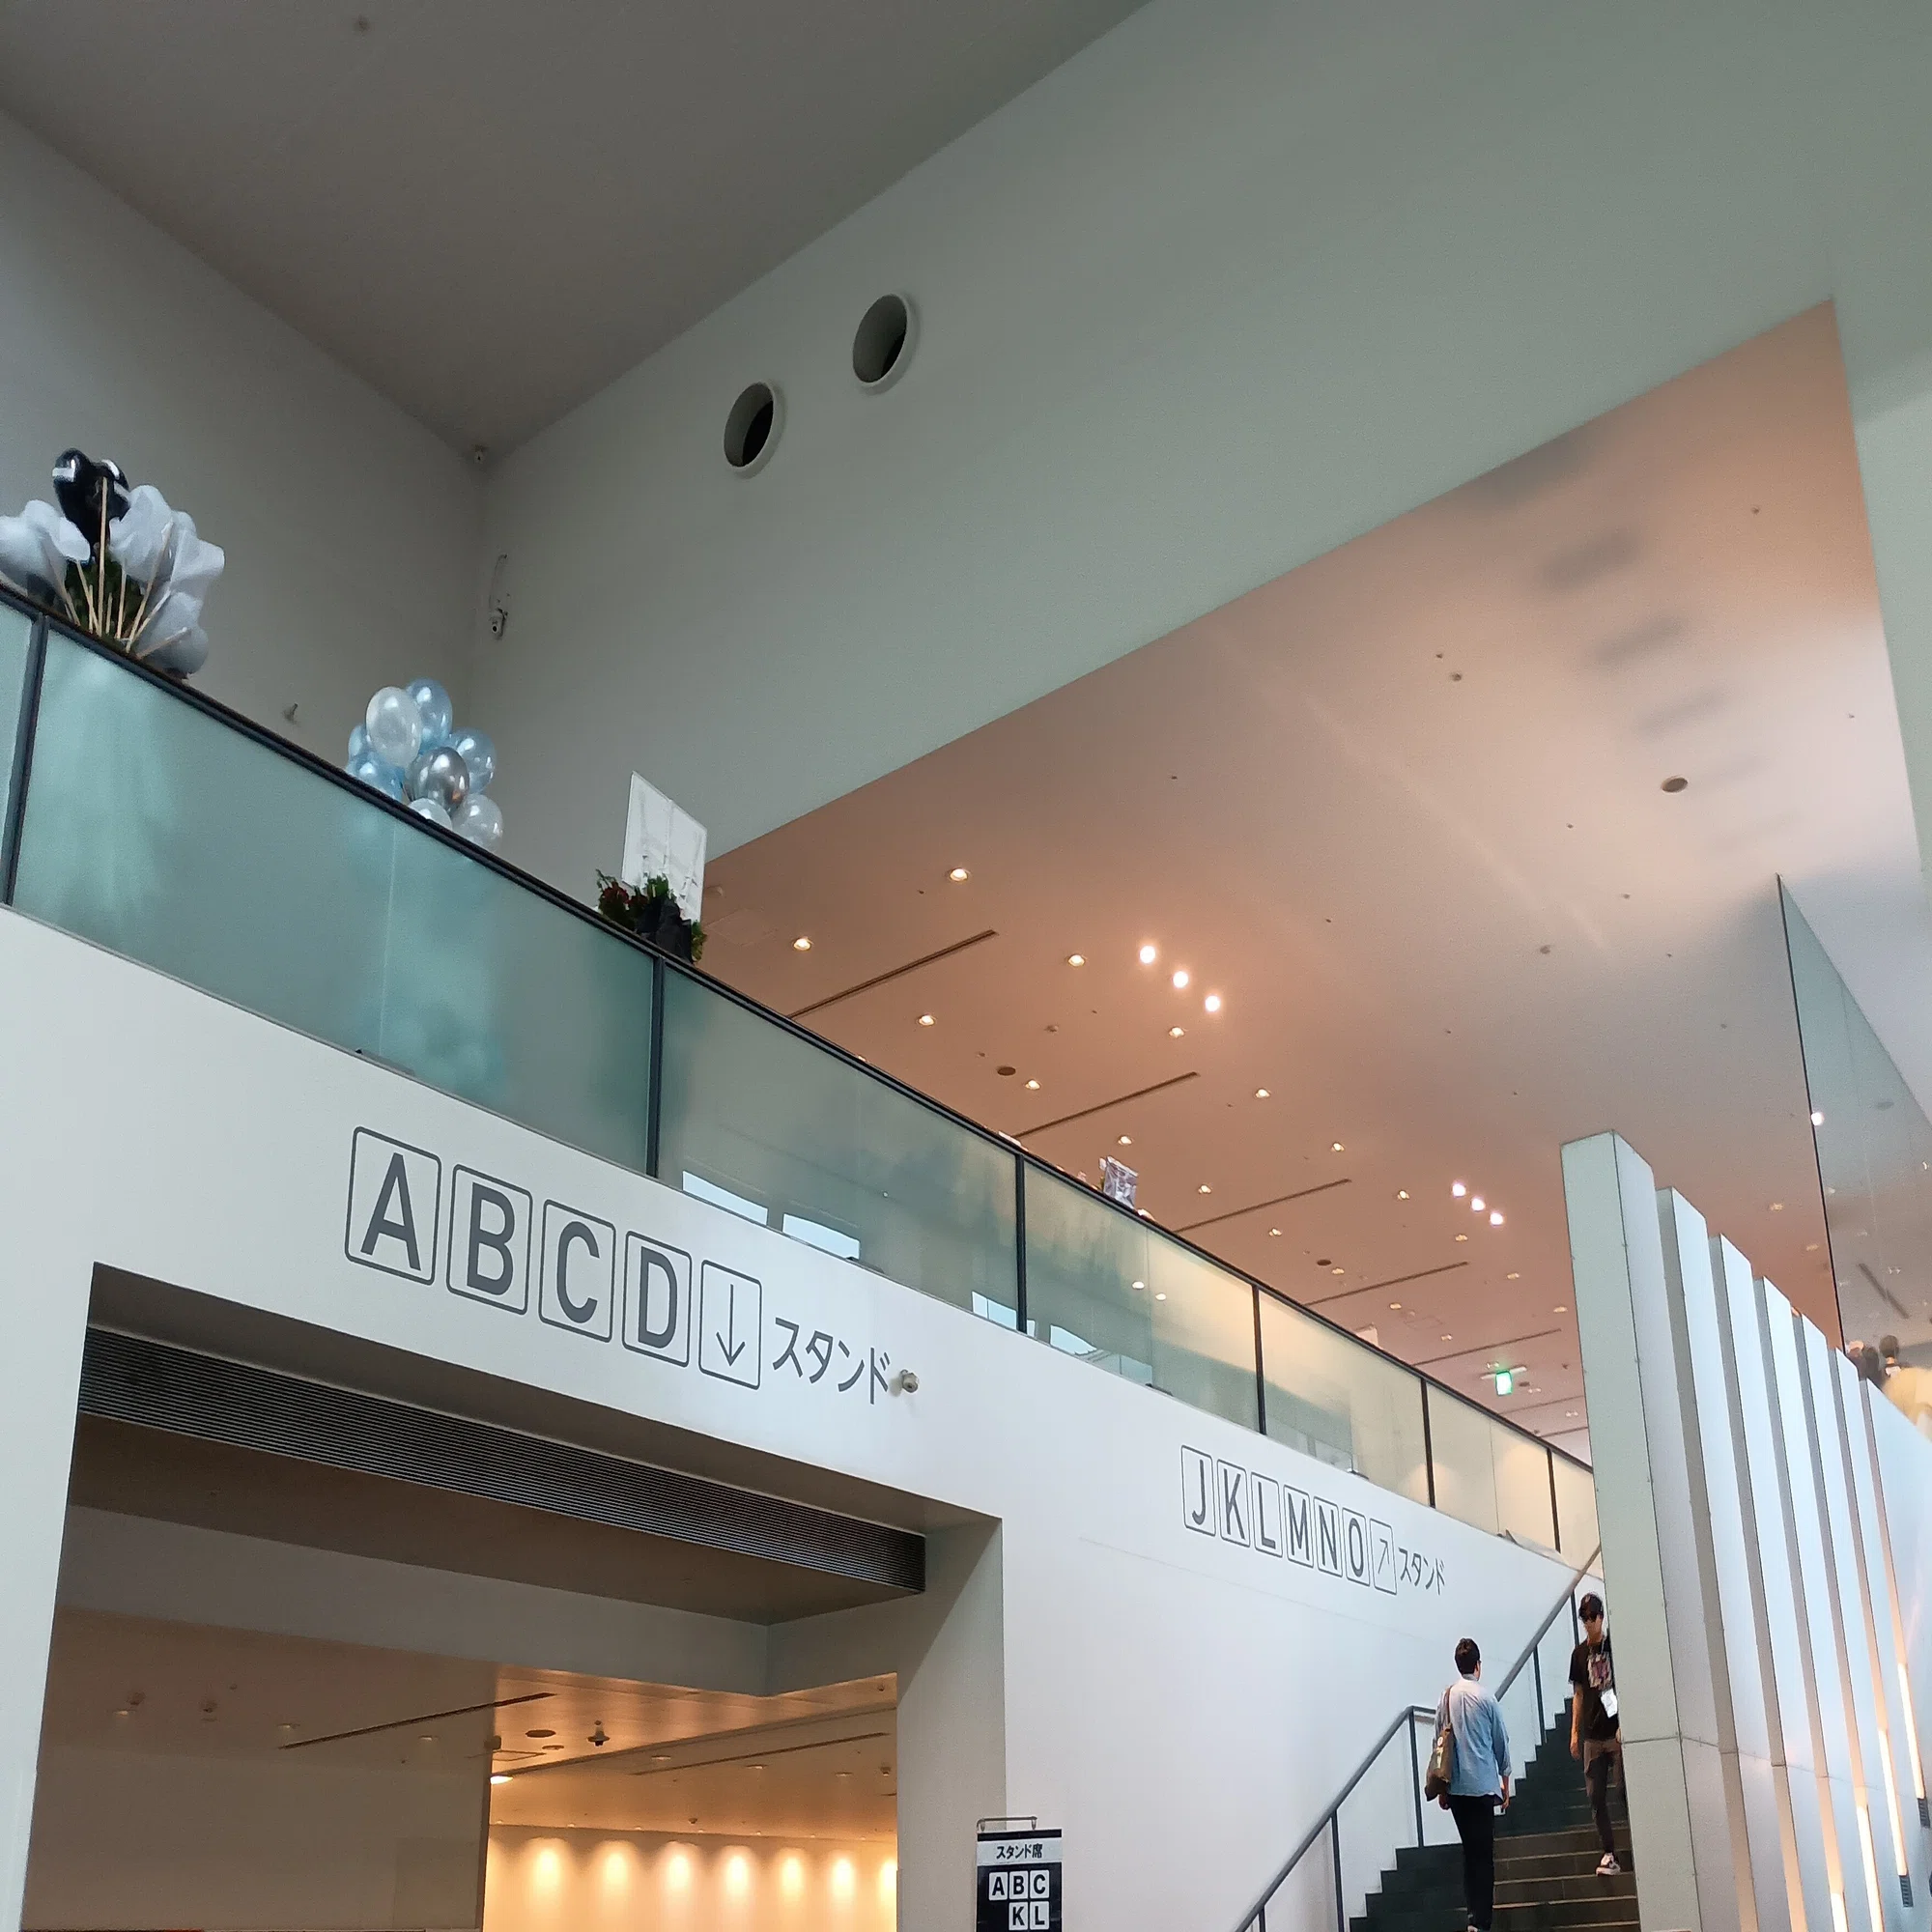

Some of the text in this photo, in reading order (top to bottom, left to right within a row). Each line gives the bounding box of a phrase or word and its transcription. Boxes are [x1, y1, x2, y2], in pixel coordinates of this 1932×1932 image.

[773, 1317, 890, 1405] スタンド
[1398, 1547, 1445, 1596] スタンド
[996, 1843, 1043, 1860] スタンド席
